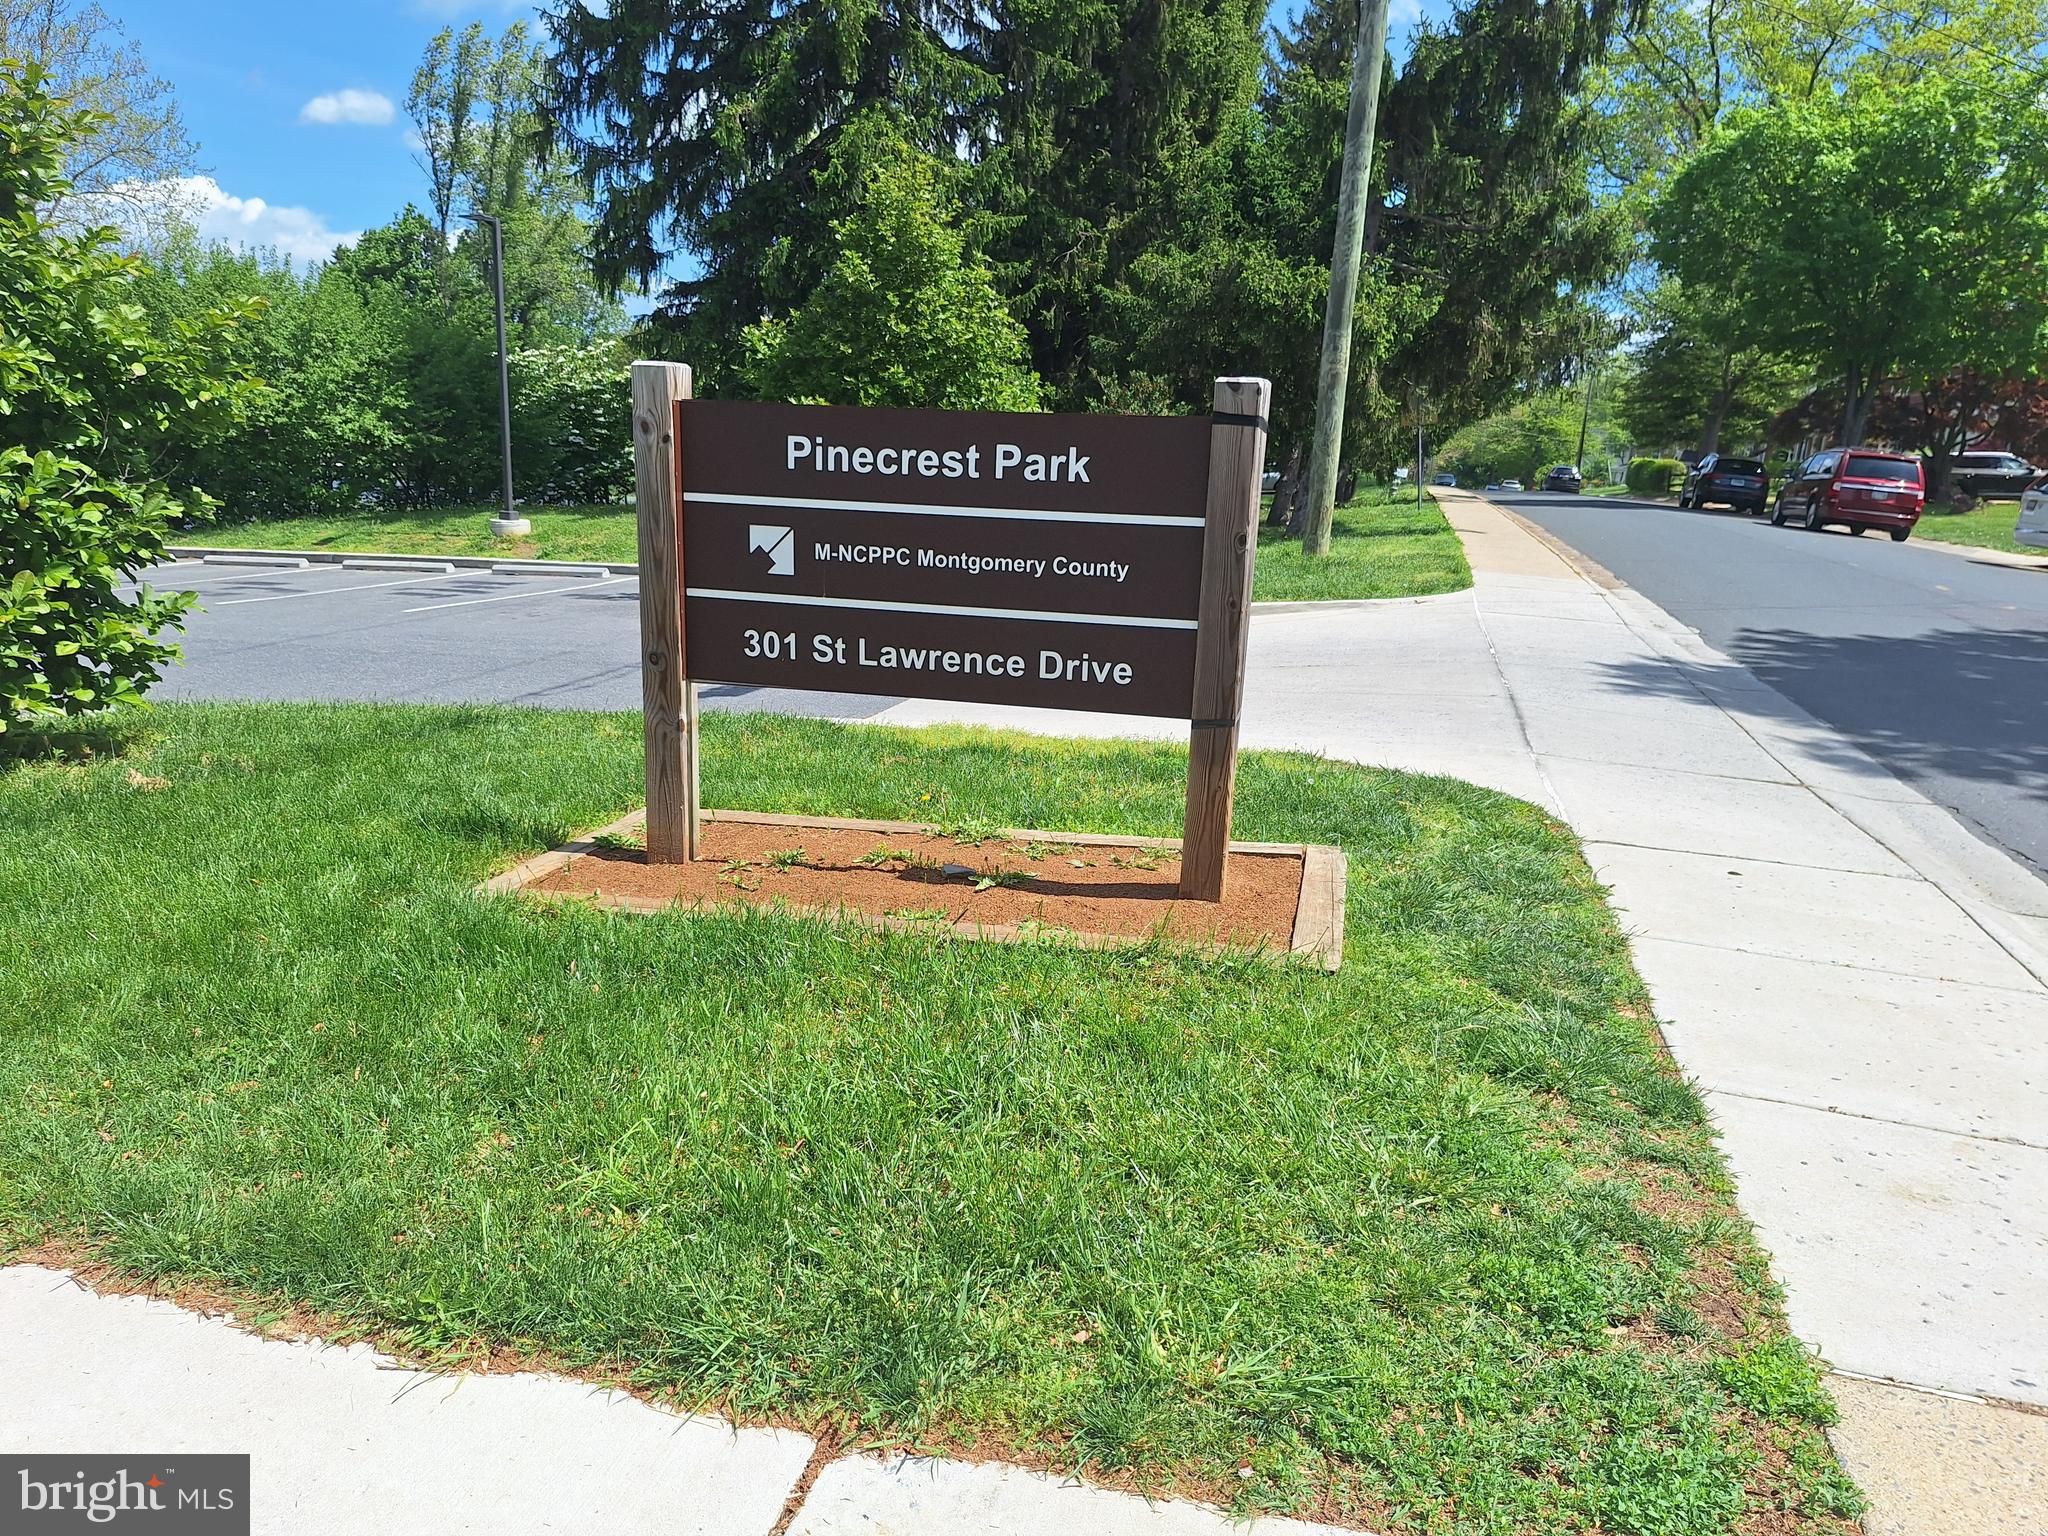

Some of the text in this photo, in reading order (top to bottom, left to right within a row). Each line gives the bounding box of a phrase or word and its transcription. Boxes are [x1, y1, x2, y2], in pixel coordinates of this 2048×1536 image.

[786, 435, 1092, 483] Pinecrest Park
[814, 542, 1131, 583] M-NCPPC Montgomery County
[743, 629, 1134, 685] 301 St Lawrence Drive
